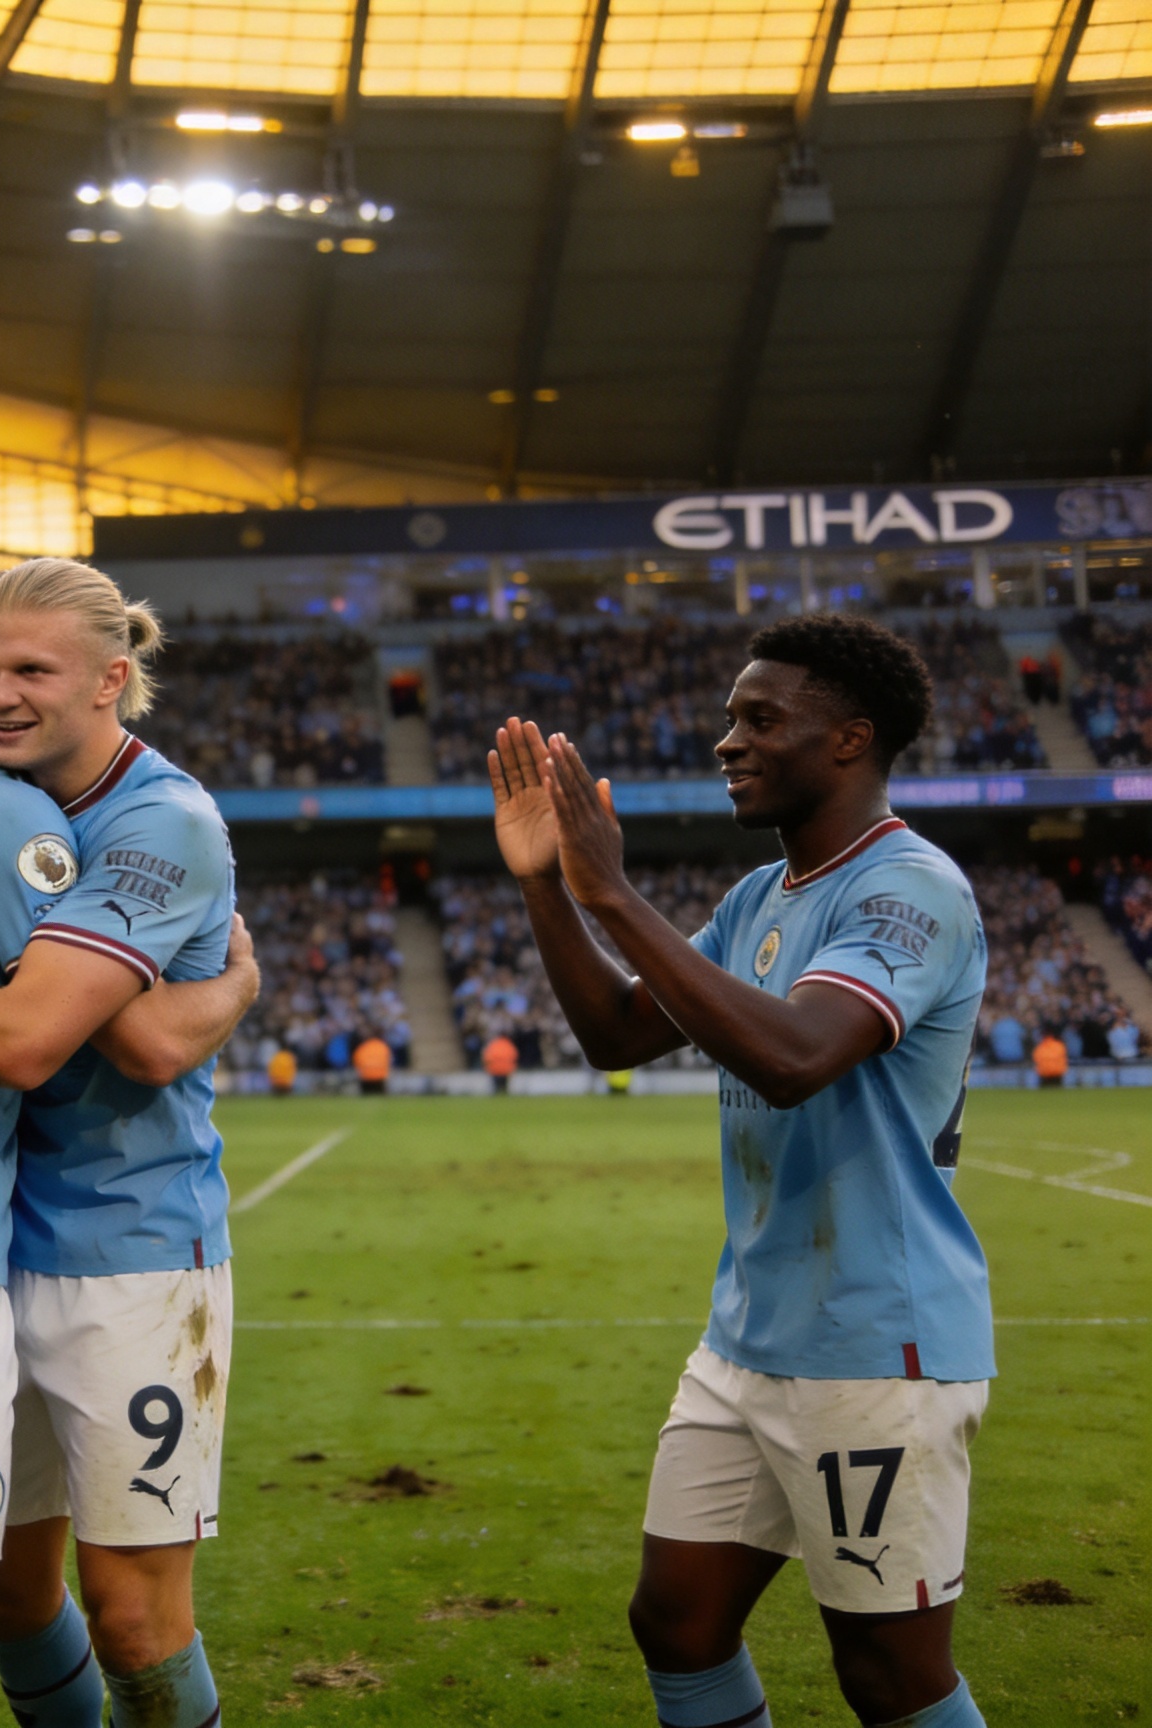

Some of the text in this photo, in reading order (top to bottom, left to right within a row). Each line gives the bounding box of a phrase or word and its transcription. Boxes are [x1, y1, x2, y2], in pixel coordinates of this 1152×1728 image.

[652, 489, 1015, 550] ETIHAD
[127, 1384, 184, 1471] 9
[816, 1446, 906, 1538] 17
